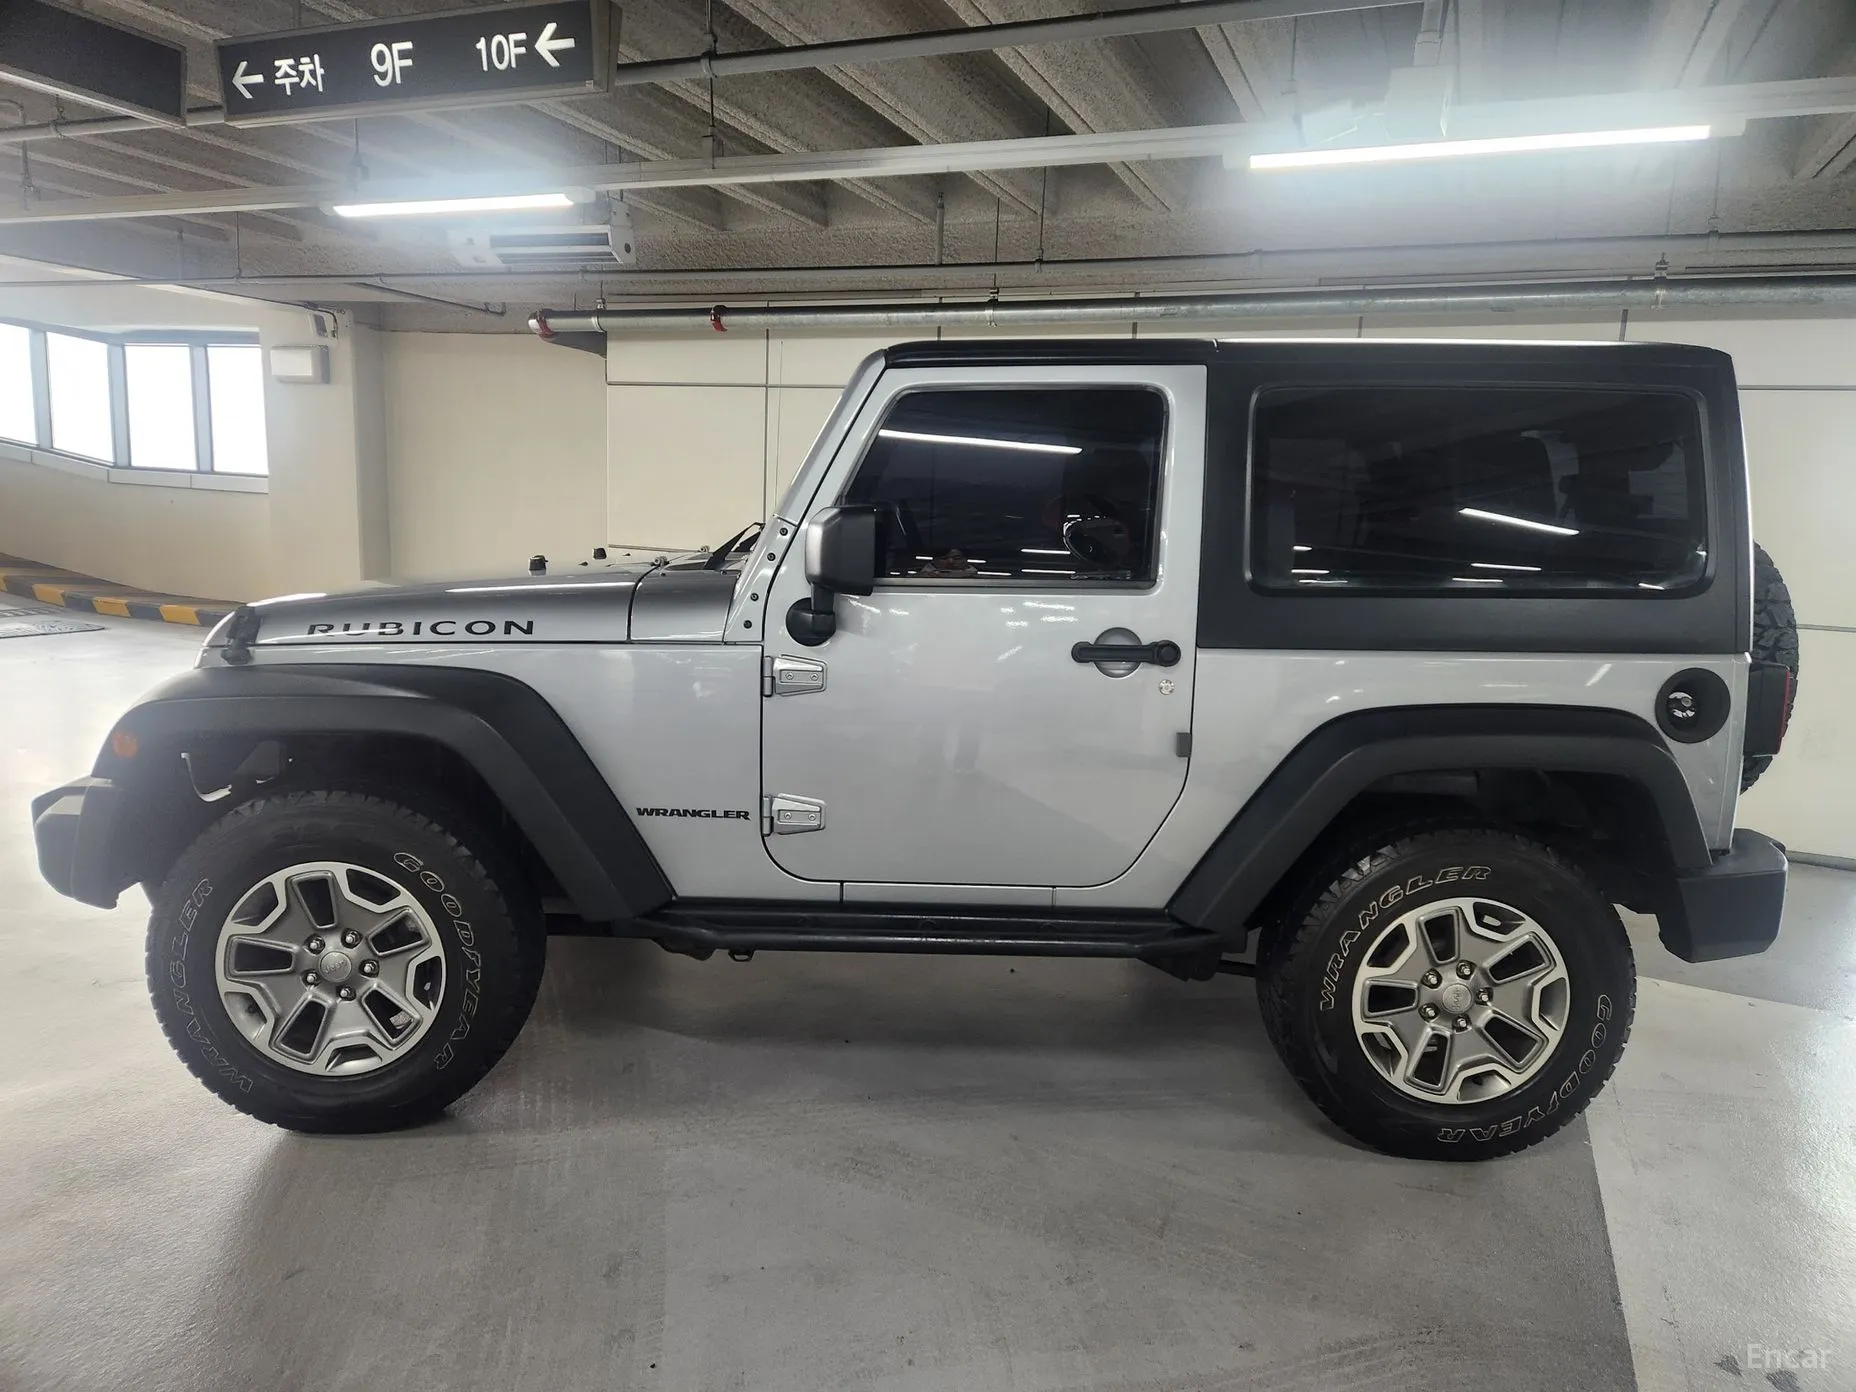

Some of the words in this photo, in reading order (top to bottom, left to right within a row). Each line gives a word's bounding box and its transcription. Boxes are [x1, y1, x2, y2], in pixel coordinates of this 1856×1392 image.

[273, 53, 325, 96] 주차
[370, 41, 414, 88] 9F
[475, 32, 528, 72] 10F
[307, 620, 535, 637] RUBICON
[636, 807, 751, 821] WRANGLER
[169, 878, 253, 1094] WRANGLER
[393, 852, 482, 1070] GOODYEAR
[1319, 865, 1492, 1012] WRANGLER
[1436, 994, 1613, 1143] GOODYEAR
